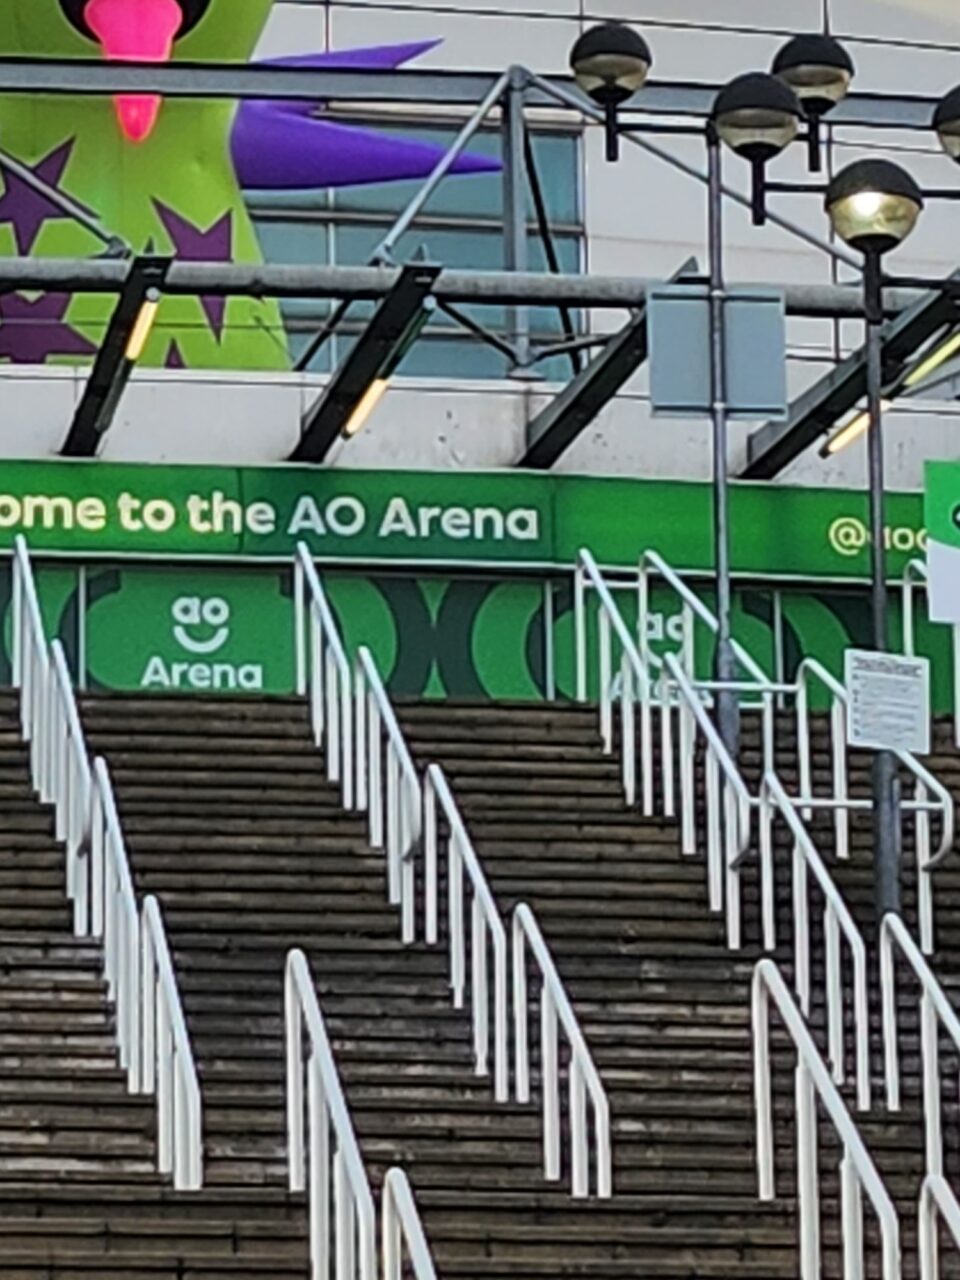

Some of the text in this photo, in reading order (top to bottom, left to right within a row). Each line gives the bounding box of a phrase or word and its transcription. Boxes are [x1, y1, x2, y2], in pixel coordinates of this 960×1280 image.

[117, 492, 176, 531] to
[187, 491, 276, 533] the
[288, 495, 366, 536] AO
[378, 496, 540, 540] Arena
[171, 596, 230, 626] ao
[140, 655, 263, 689] Arena
